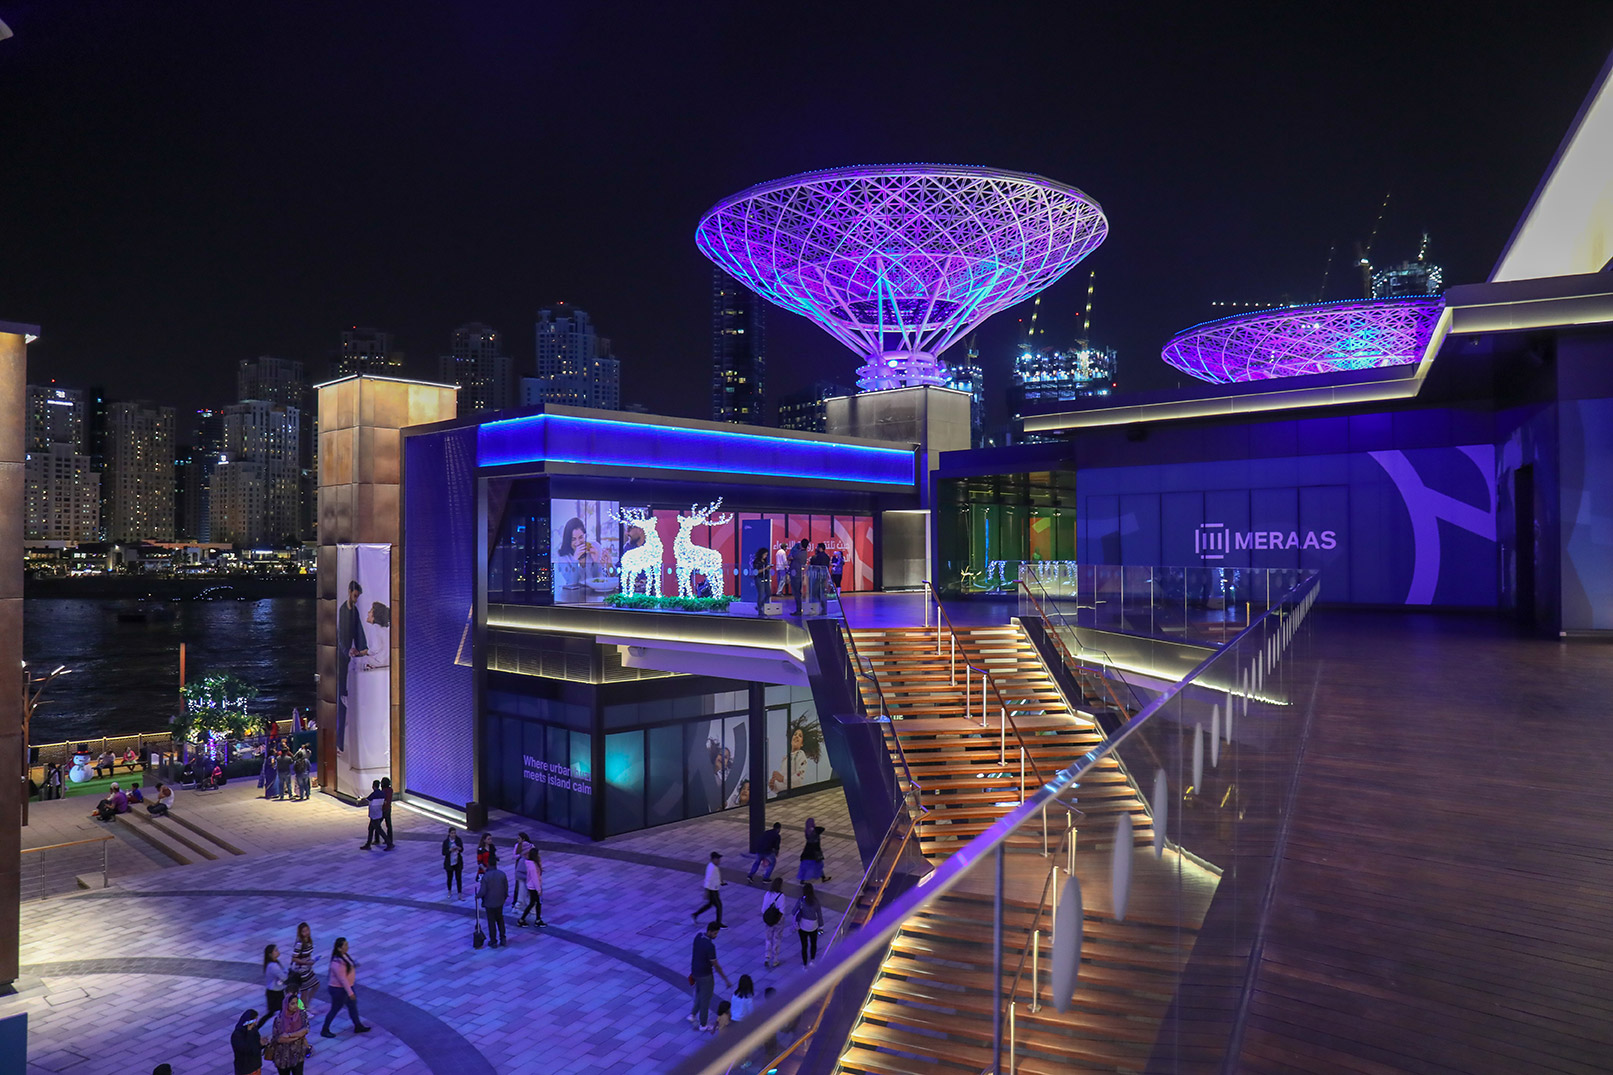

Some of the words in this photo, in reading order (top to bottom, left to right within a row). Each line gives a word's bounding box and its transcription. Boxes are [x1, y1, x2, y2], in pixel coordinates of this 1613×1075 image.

[1235, 531, 1337, 550] MERAAS
[523, 754, 548, 770] Where
[549, 763, 573, 777] urban
[523, 768, 547, 783] meets
[547, 774, 571, 789] island
[572, 782, 592, 795] calm
